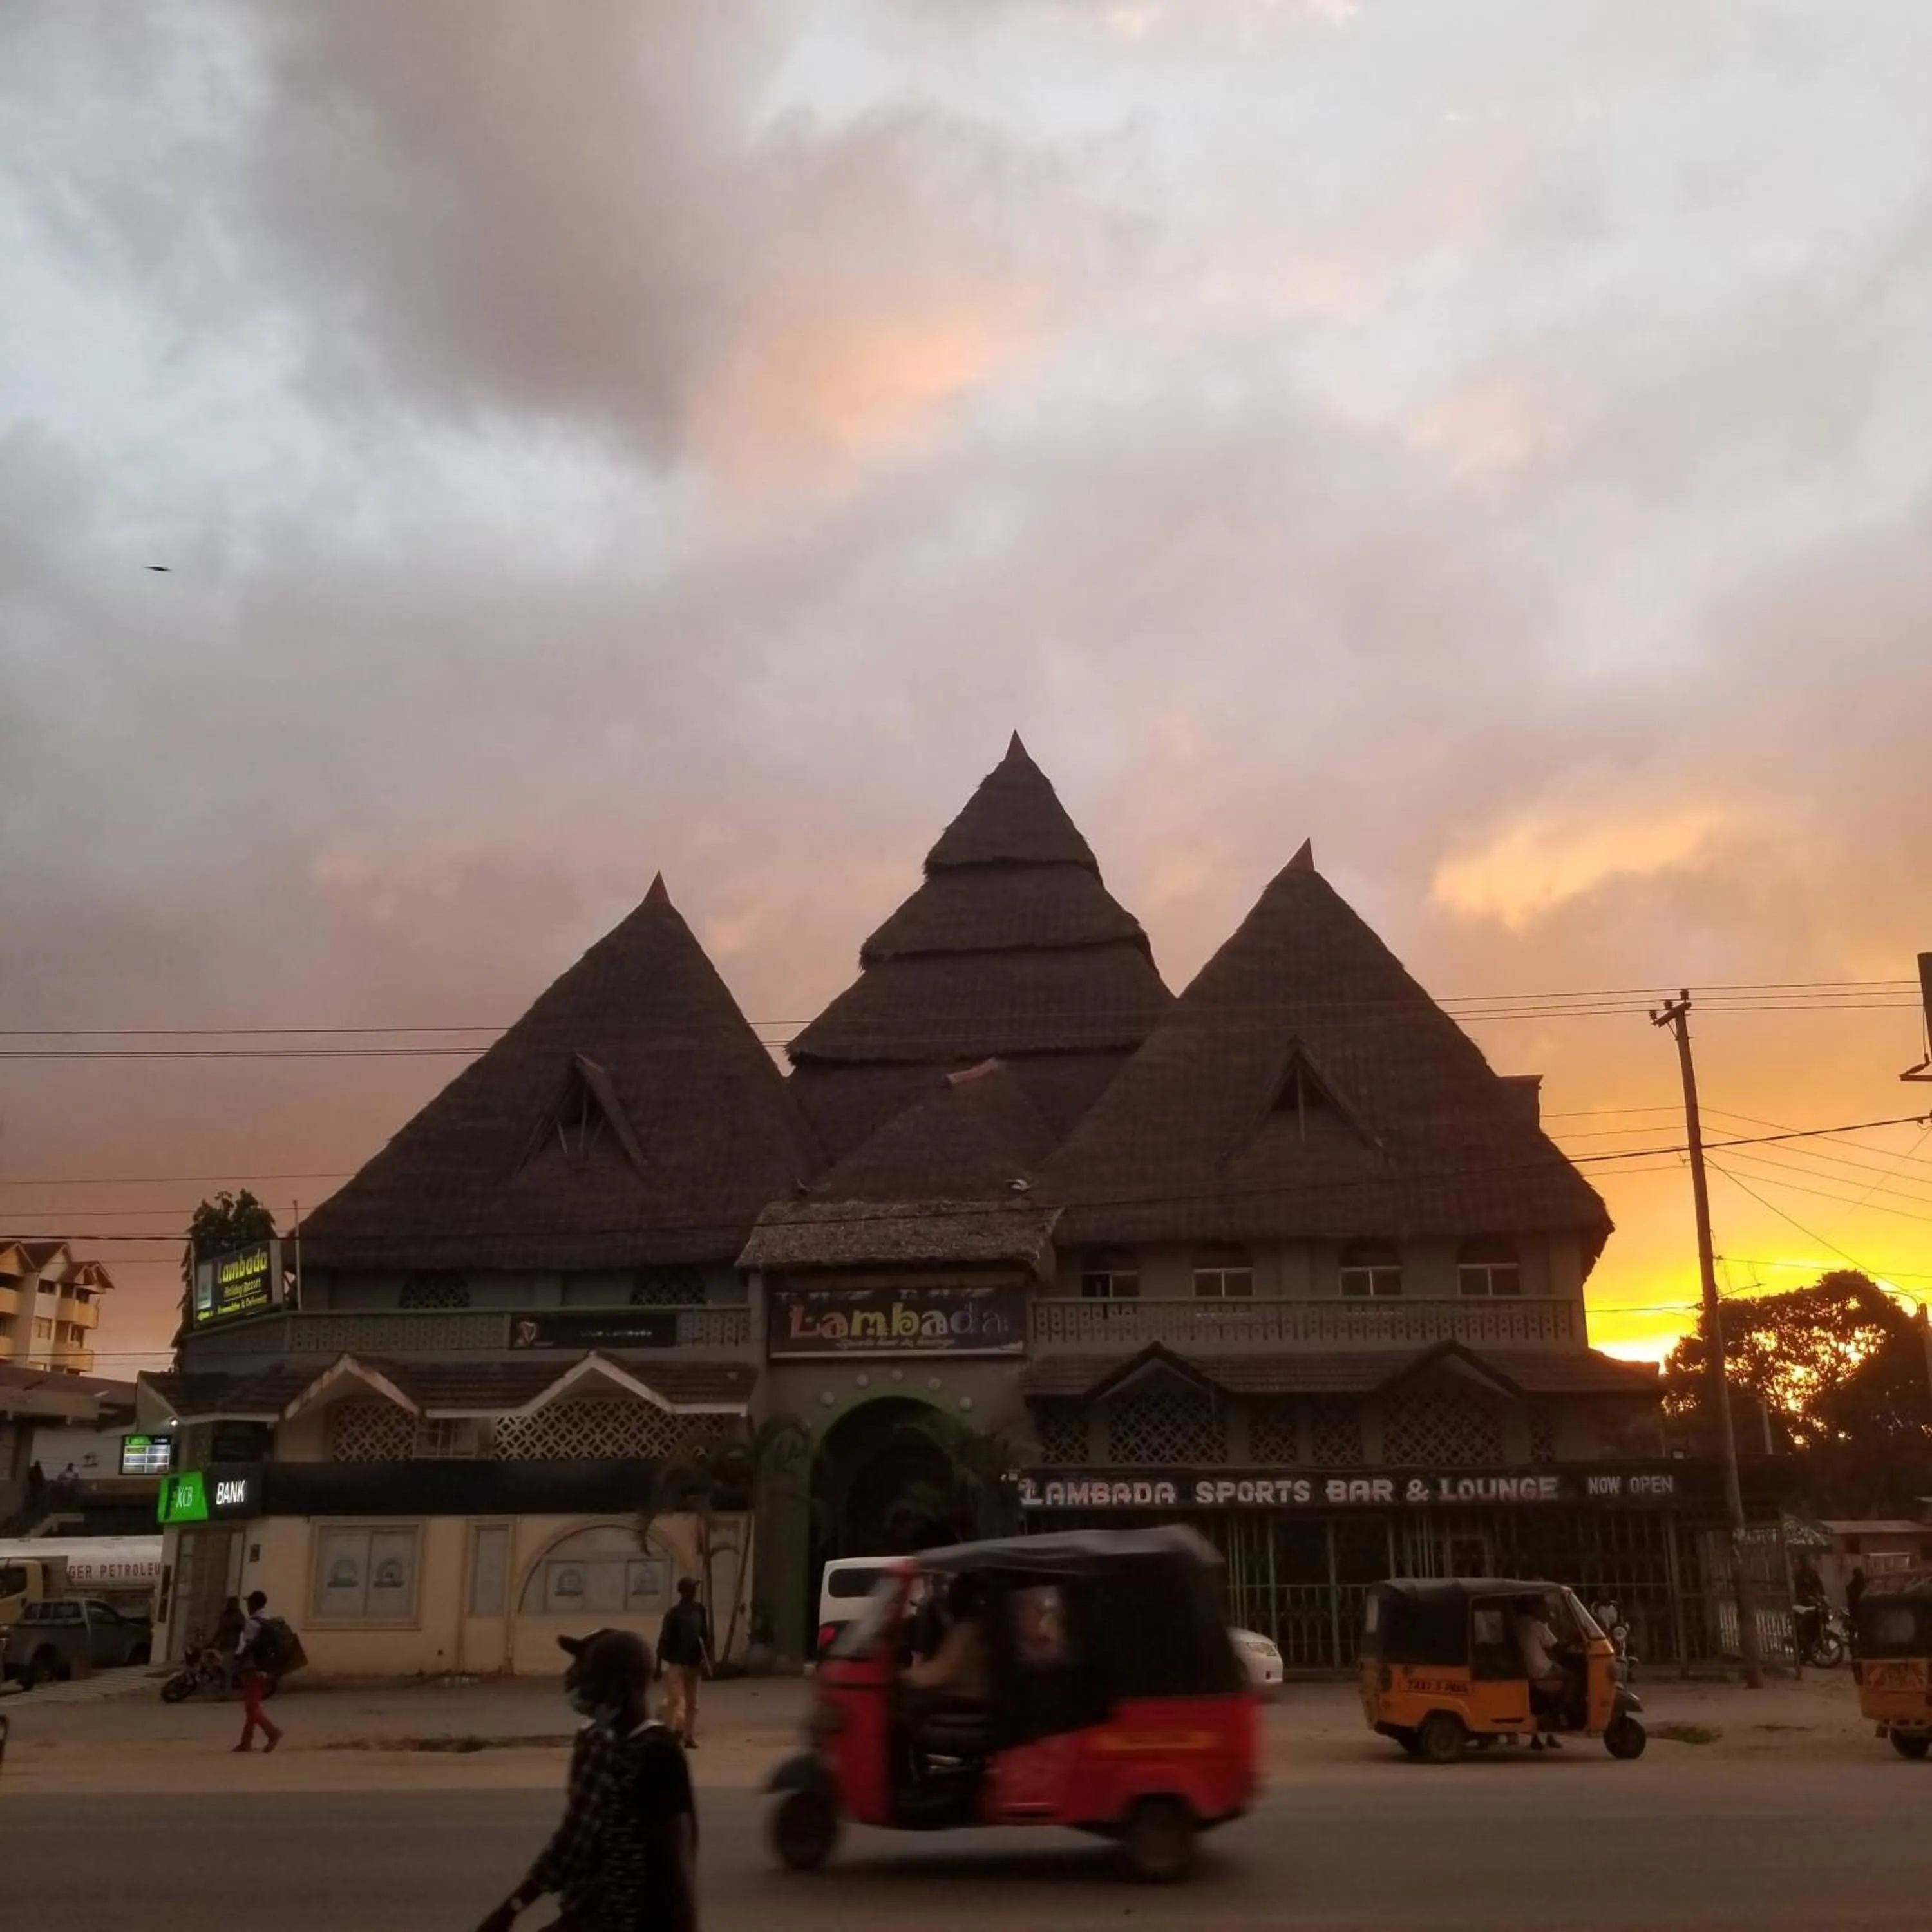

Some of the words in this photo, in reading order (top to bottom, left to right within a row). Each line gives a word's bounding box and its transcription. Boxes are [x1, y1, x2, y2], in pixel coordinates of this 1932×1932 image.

[789, 1302, 1009, 1338] Lambada
[216, 1480, 246, 1505] BANK
[1018, 1477, 1177, 1506] LAMBADA
[1195, 1479, 1311, 1504] SPORTS
[1325, 1479, 1394, 1503] BAR
[1406, 1479, 1430, 1502] &
[1439, 1475, 1559, 1502] LOUNGE
[1587, 1475, 1622, 1495] NOW
[1629, 1474, 1674, 1493] OPEN
[68, 1565, 92, 1579] GER
[100, 1562, 161, 1578] PETROLEU
